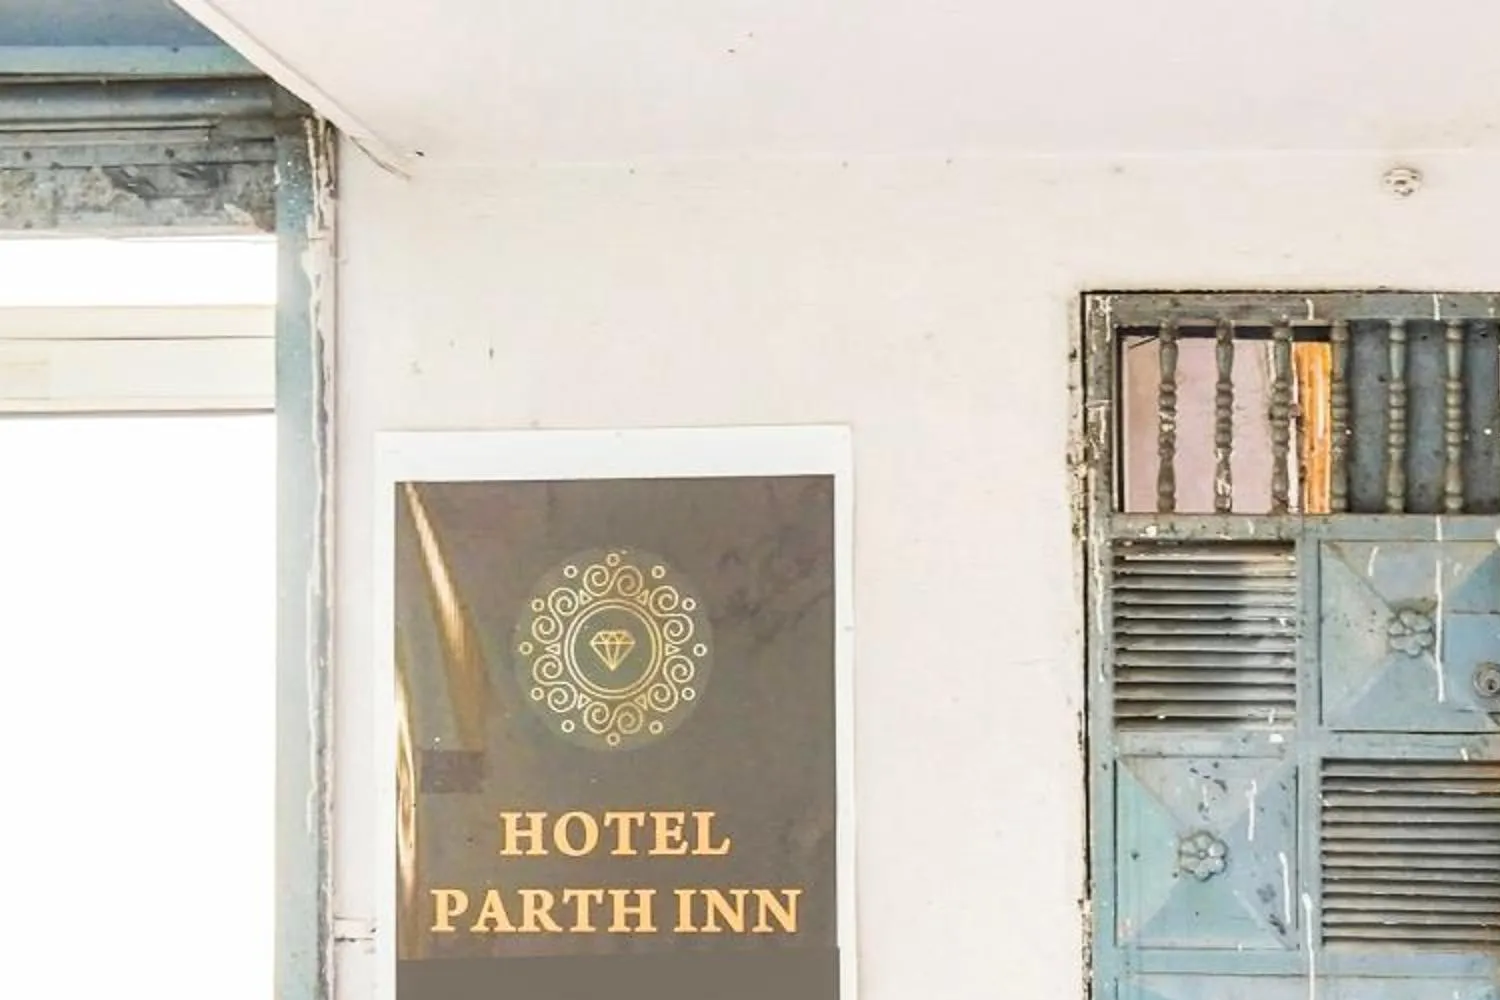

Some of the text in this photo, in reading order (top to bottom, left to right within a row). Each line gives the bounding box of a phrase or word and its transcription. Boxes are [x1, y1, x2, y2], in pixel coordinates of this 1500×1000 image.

[498, 809, 732, 858] HOTEL
[430, 887, 802, 934] PARTH INN
